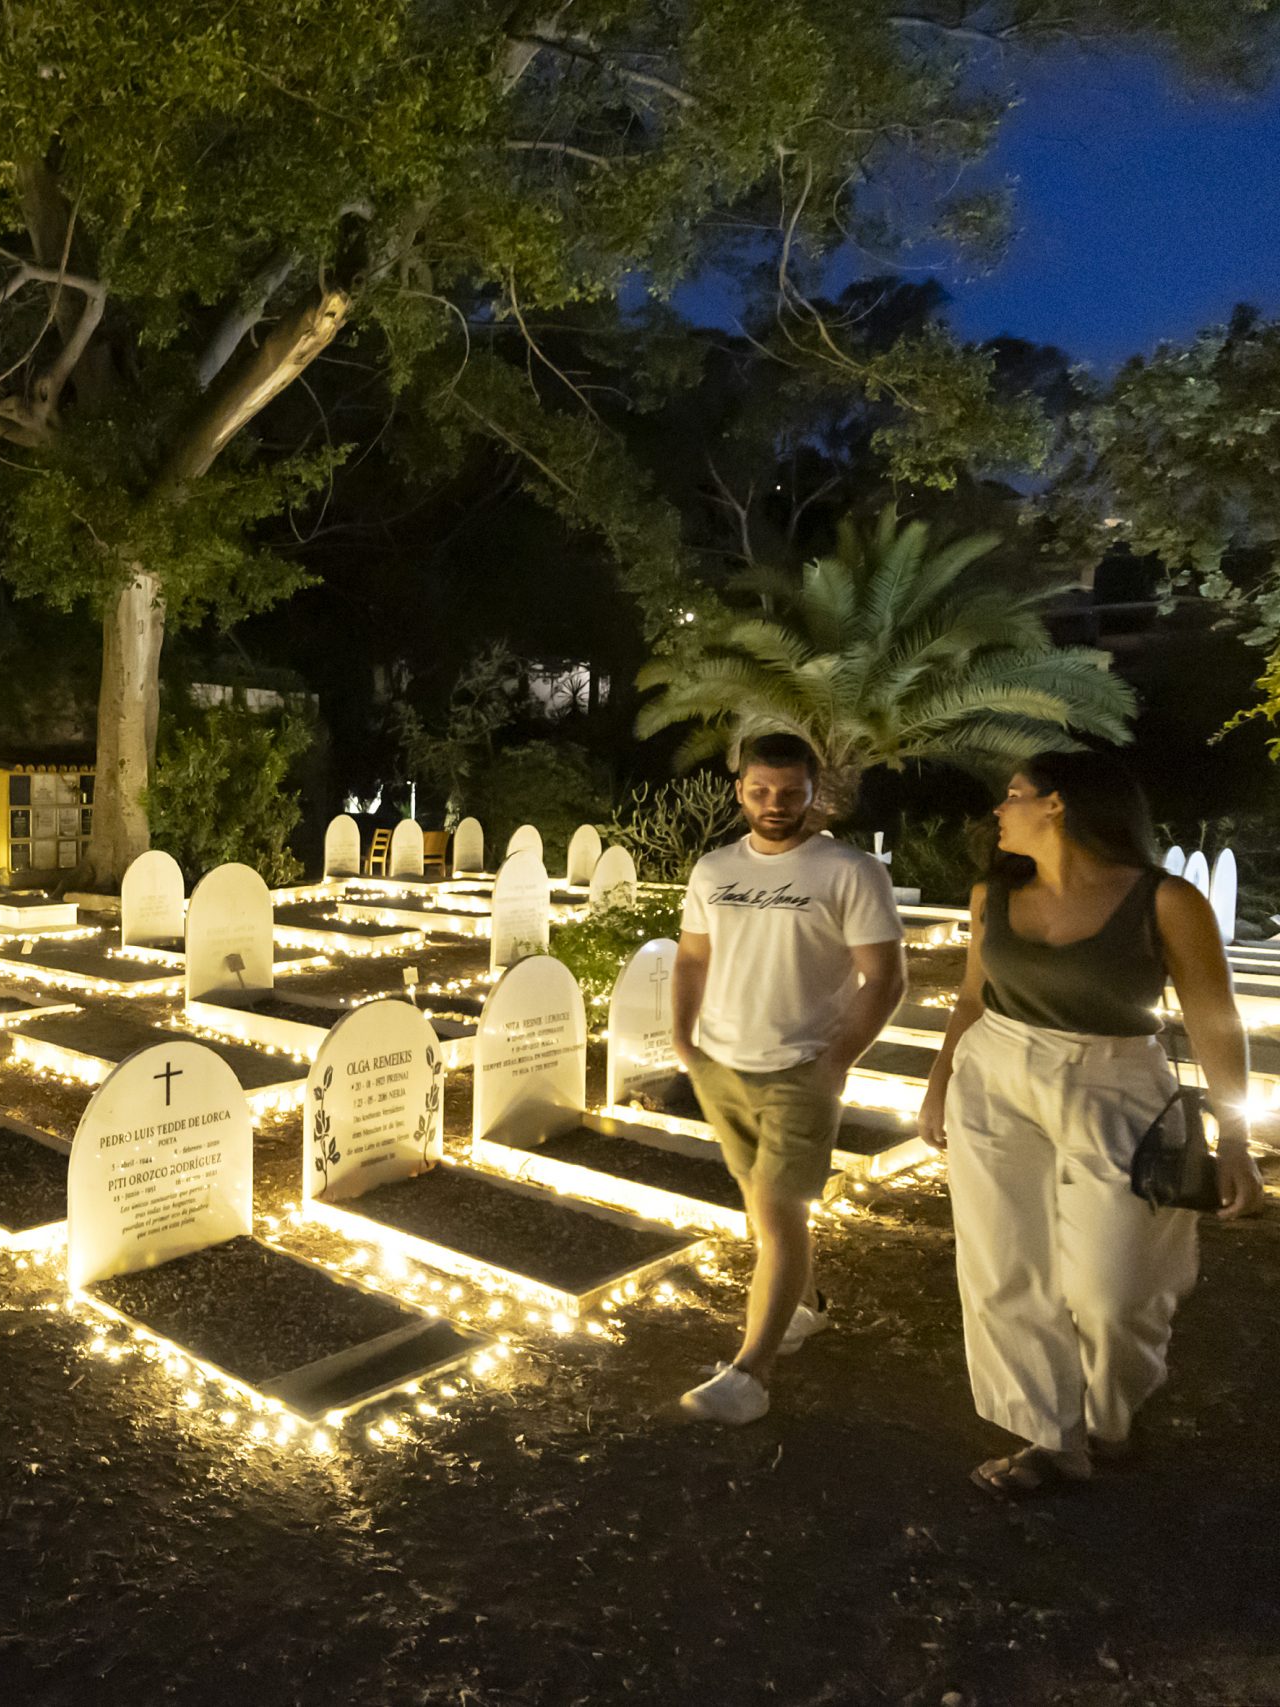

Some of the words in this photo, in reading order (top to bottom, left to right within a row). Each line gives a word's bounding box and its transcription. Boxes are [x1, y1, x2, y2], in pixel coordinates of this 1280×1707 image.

[708, 881, 754, 905] Jack
[750, 890, 767, 905] &
[759, 881, 812, 909] Jones
[346, 1060, 370, 1076] OLGA
[373, 1049, 413, 1070] REMEIKIS
[99, 1131, 132, 1149] PEDRO
[134, 1126, 154, 1141] LUIS
[156, 1119, 186, 1135] TEDDE
[188, 1116, 200, 1128] DE
[201, 1110, 231, 1125] LORCA
[158, 1137, 177, 1147] POETA
[108, 1176, 127, 1192] PITI
[128, 1167, 168, 1185] OROZCO
[170, 1152, 222, 1176] RODRÍGUEZ
